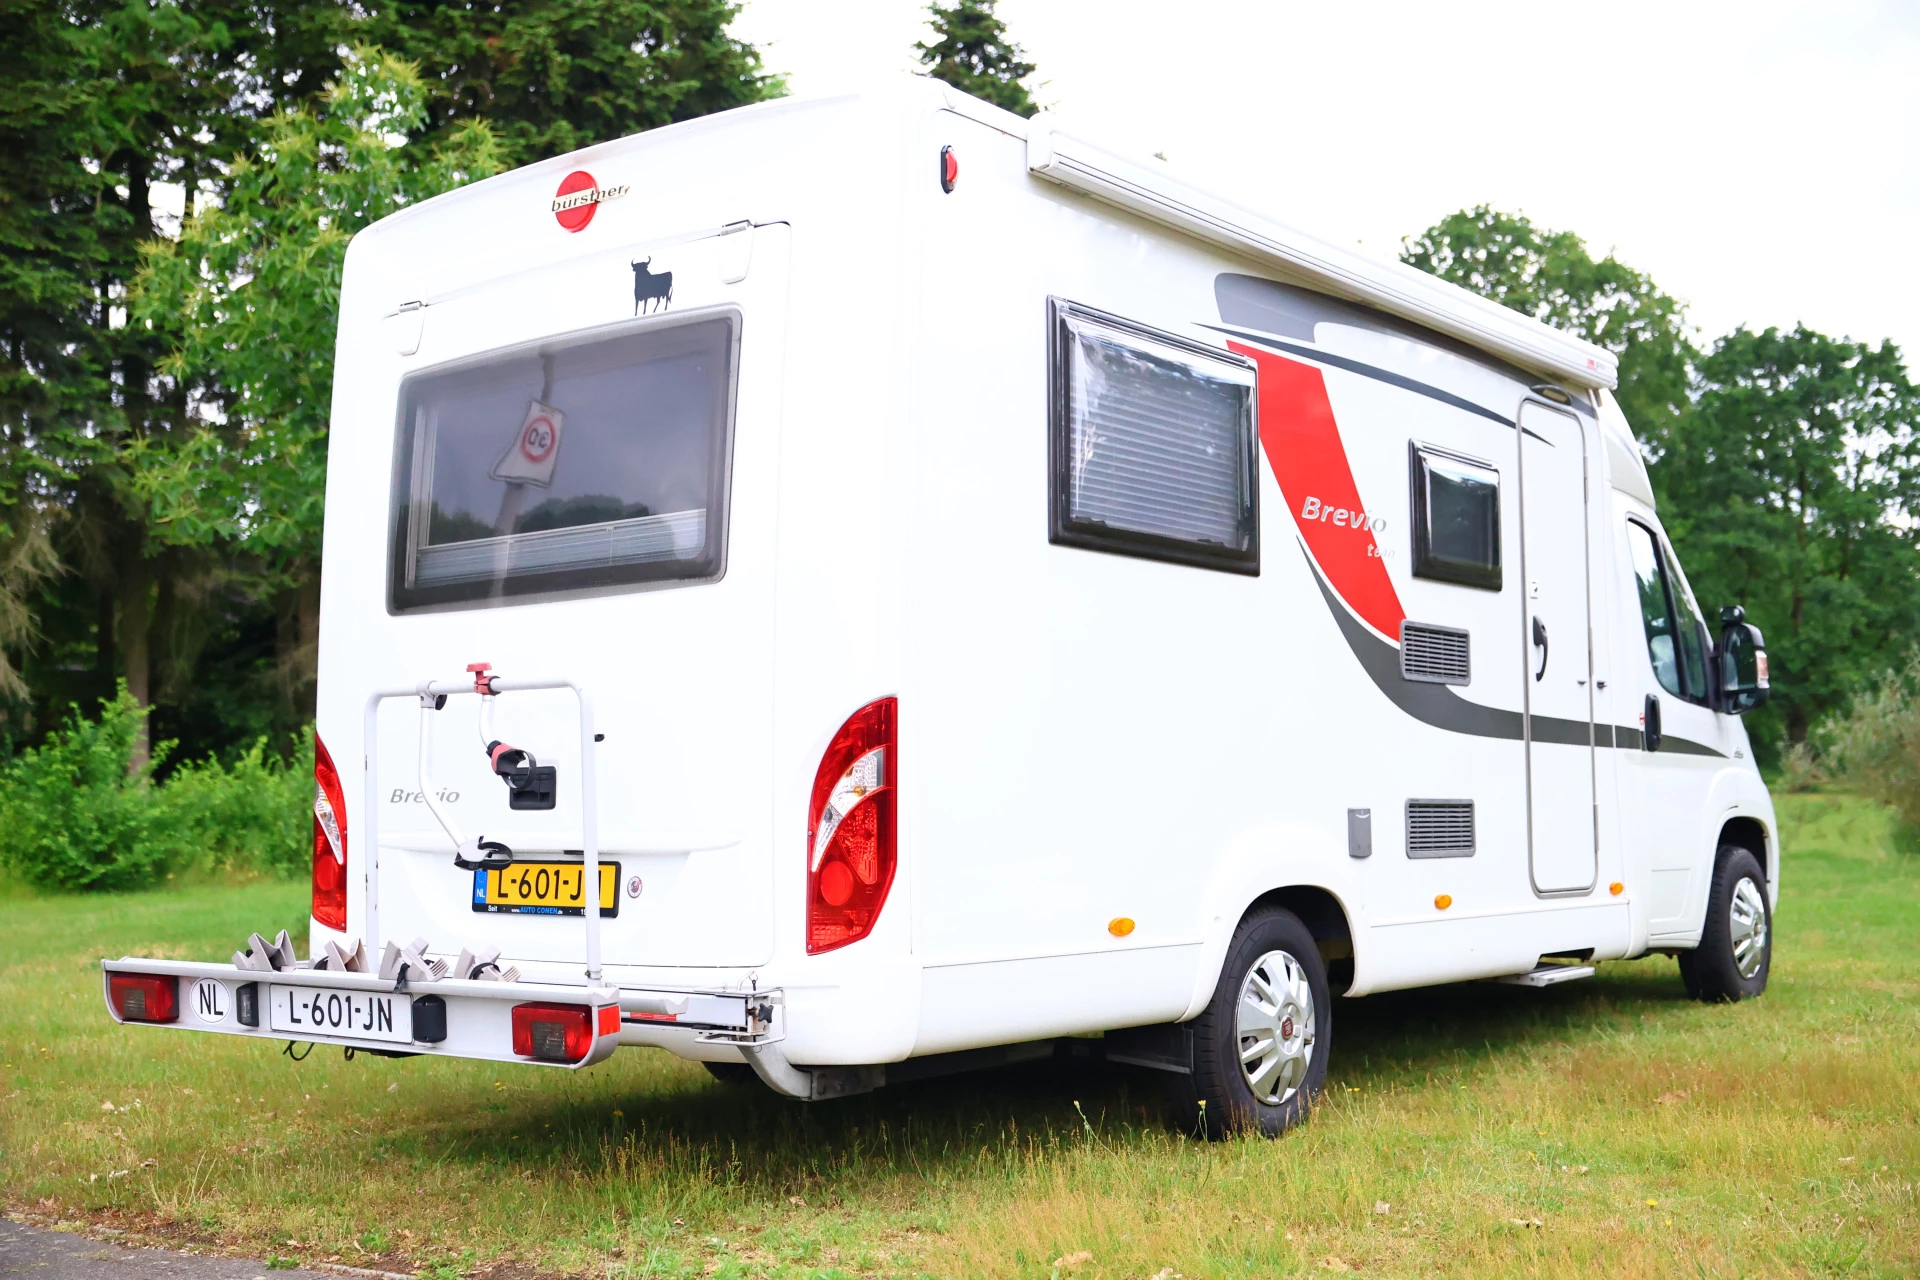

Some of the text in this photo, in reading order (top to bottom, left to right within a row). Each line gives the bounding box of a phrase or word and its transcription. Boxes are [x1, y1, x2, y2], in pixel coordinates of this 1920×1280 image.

[551, 184, 625, 212] bürstner
[1301, 496, 1387, 532] Brevio
[389, 787, 460, 804] Breio
[476, 888, 486, 898] NL
[200, 983, 223, 1016] NL
[289, 991, 392, 1032] L-601-JN
